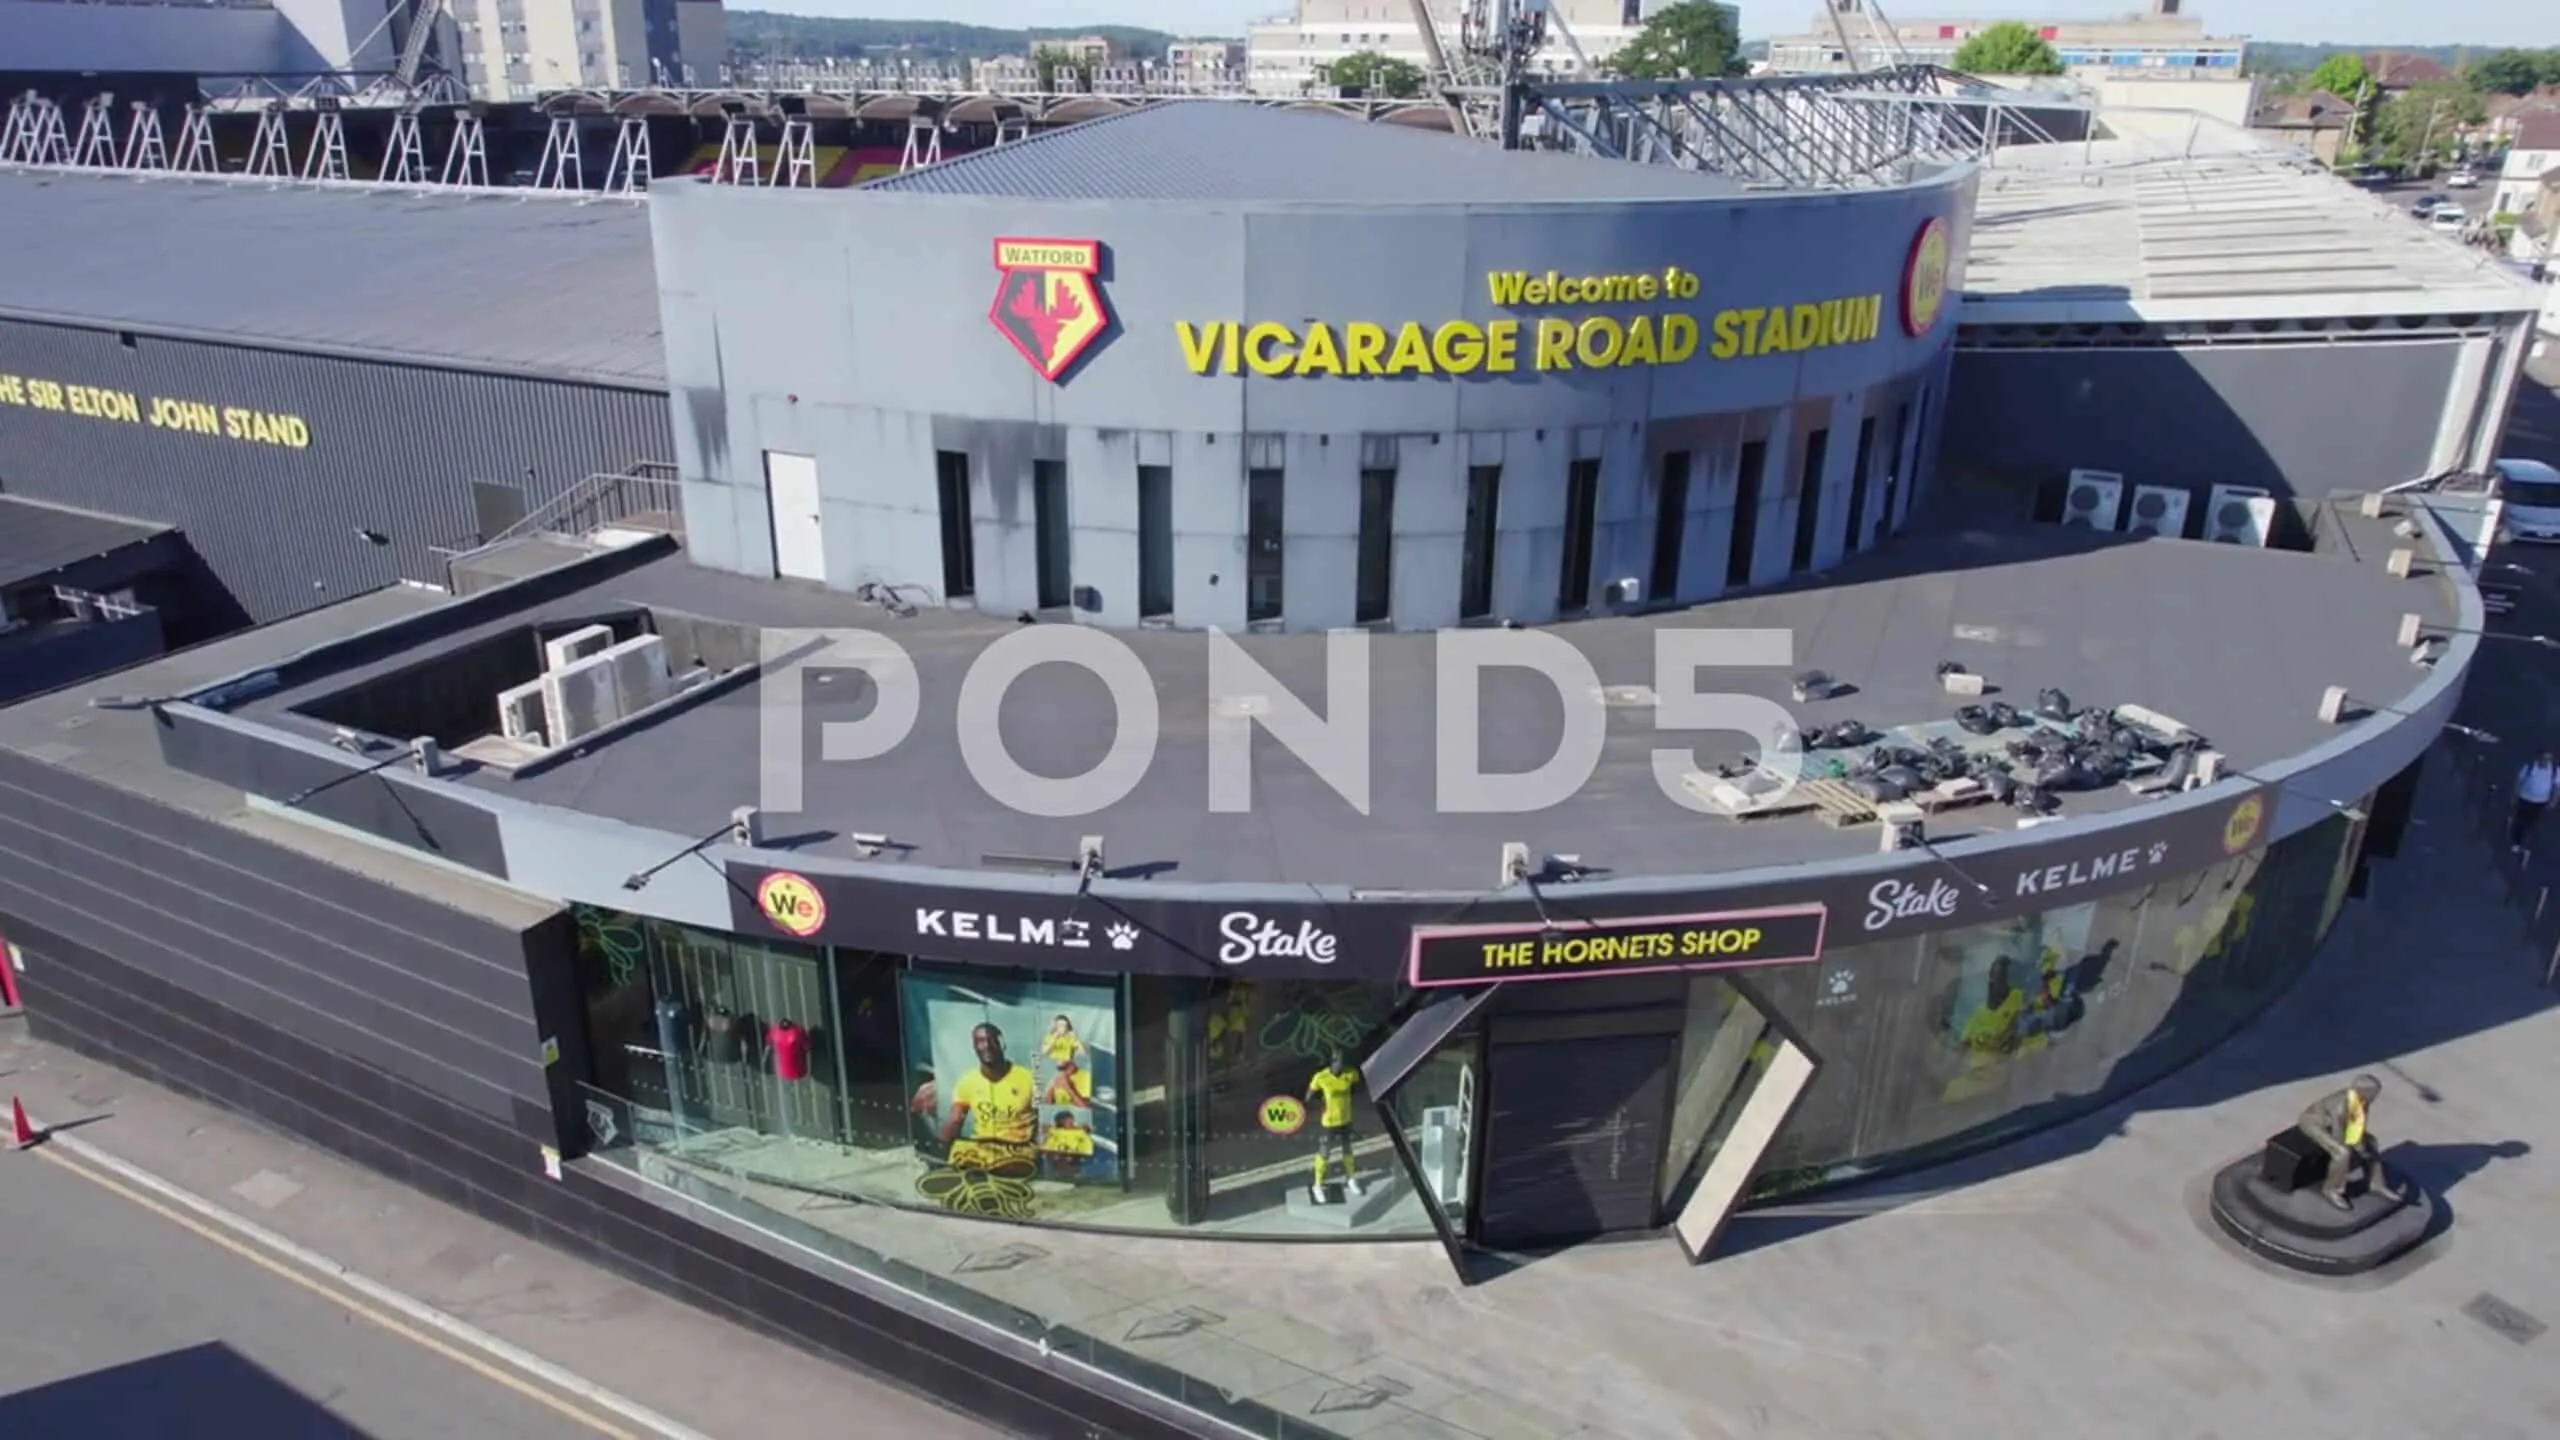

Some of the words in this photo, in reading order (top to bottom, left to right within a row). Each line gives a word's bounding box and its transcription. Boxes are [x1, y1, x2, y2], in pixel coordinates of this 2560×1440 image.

[1005, 247, 1085, 265] WATFORD
[1488, 270, 1656, 304] Welcome
[1666, 266, 1698, 298] to
[1175, 320, 1517, 374] VICARAGE
[1537, 313, 1697, 370] ROAD
[1711, 294, 1881, 359] STADIUM
[0, 374, 26, 406] HE
[27, 378, 65, 410] SIR
[66, 384, 140, 423] ELTON
[150, 396, 220, 436] JOHN
[223, 407, 310, 448] STAND
[2015, 848, 2140, 896] KELME
[769, 891, 815, 918] We
[1864, 878, 1960, 931] Stake
[1219, 911, 1337, 964] Stake
[1482, 942, 1534, 967] THE
[1541, 932, 1674, 964] HORNETS
[1681, 928, 1761, 956] SHOP
